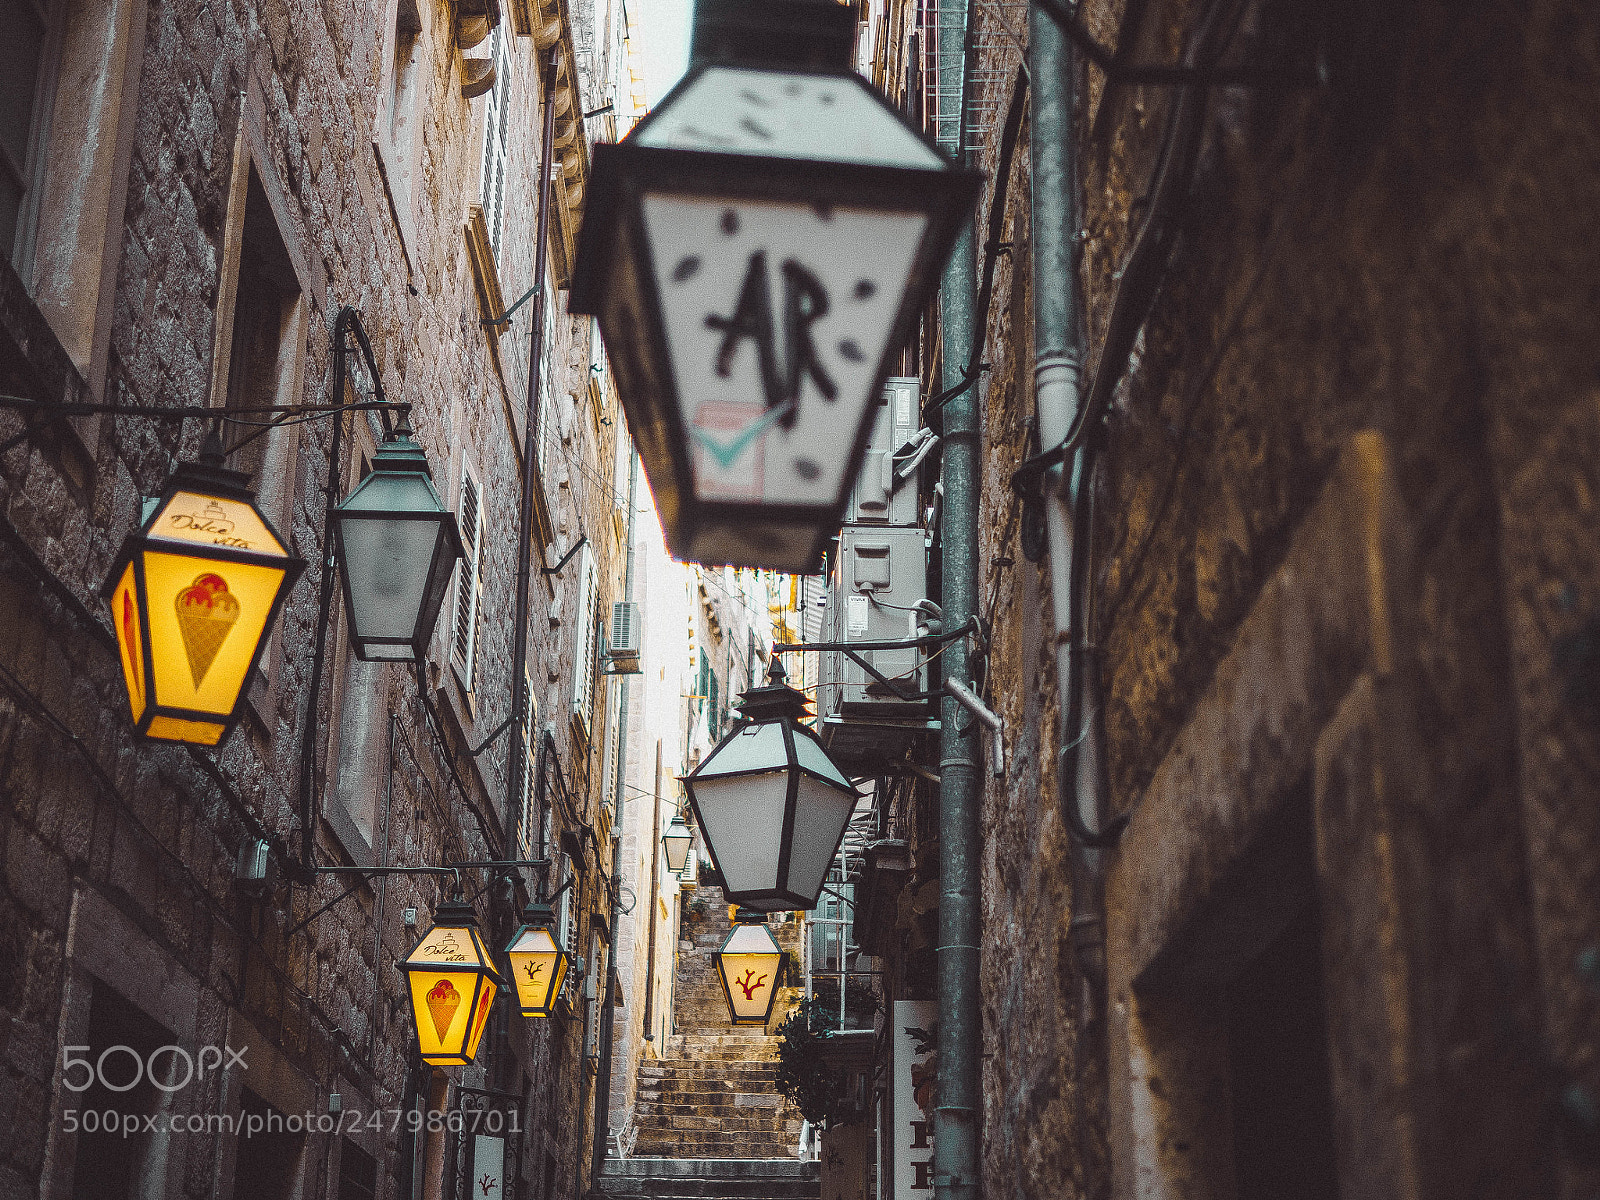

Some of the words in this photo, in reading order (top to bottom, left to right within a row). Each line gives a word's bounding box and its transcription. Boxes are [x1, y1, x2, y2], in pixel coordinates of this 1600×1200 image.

[170, 514, 229, 535] Dolce
[423, 945, 455, 957] Dolce
[445, 953, 467, 962] vita
